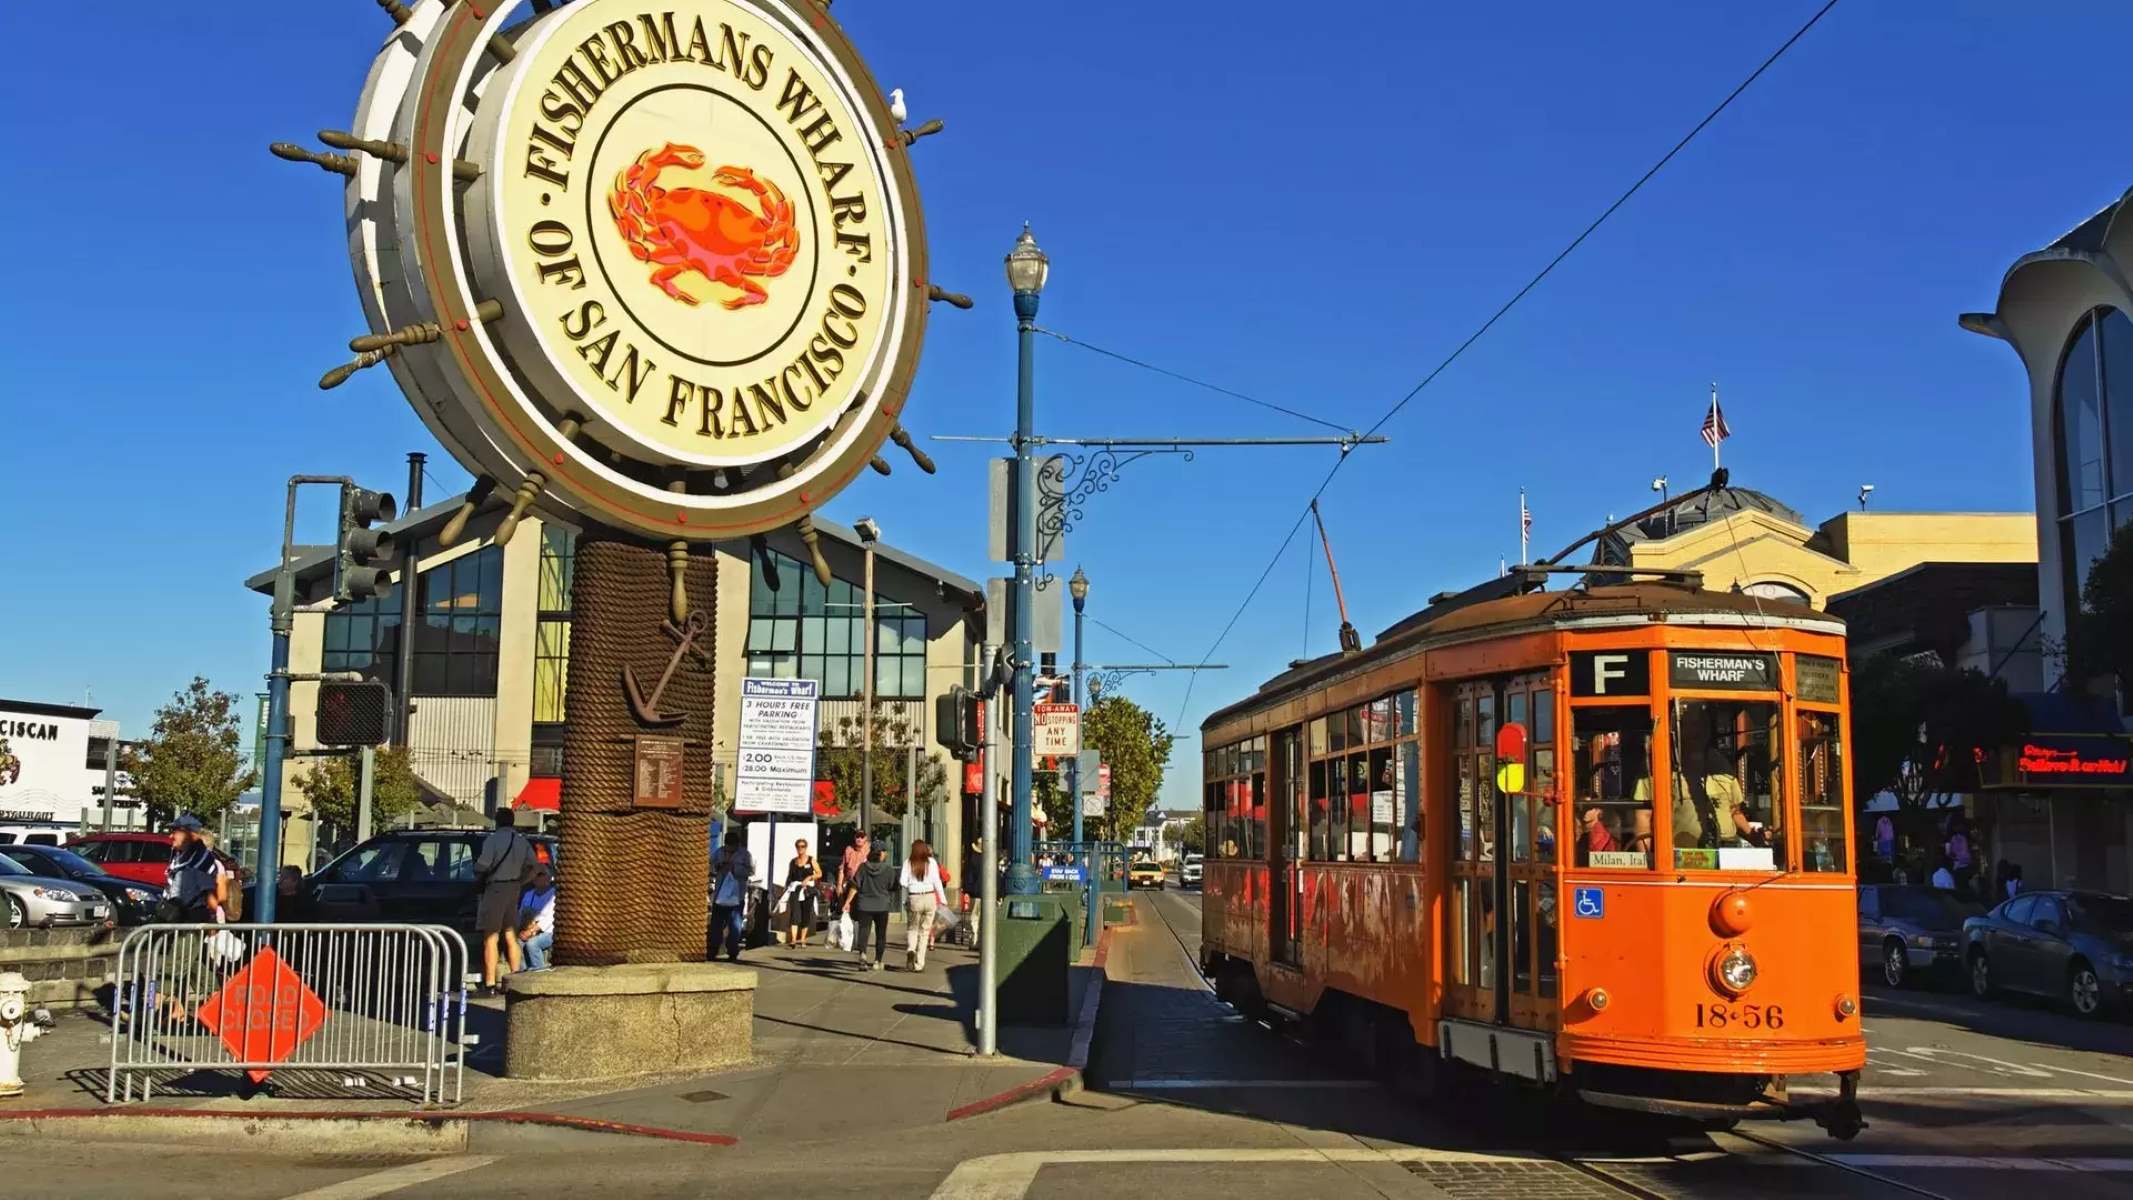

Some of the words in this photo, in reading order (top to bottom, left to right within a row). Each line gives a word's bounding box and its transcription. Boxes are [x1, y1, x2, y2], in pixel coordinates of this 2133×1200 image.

[524, 11, 775, 193] FISHERMANS
[775, 67, 873, 264] WHARF
[529, 219, 587, 291] OF
[559, 300, 657, 404] SAN
[661, 283, 868, 439] FRANCISCO
[1676, 656, 1765, 671] FISHERMAN'S
[1594, 655, 1628, 694] F
[1697, 669, 1745, 682] WHARF
[747, 700, 752, 708] 3
[756, 701, 786, 710] HOURS
[790, 702, 811, 711] FREE
[758, 711, 798, 719] PARKING
[1034, 713, 1046, 725] NO
[1048, 715, 1076, 725] STOPPING
[0, 720, 58, 740] CISCAN
[1047, 728, 1065, 736] ANY
[1046, 737, 1066, 746] TIME
[1593, 854, 1626, 866] Milan,
[234, 984, 297, 1006] ROAD
